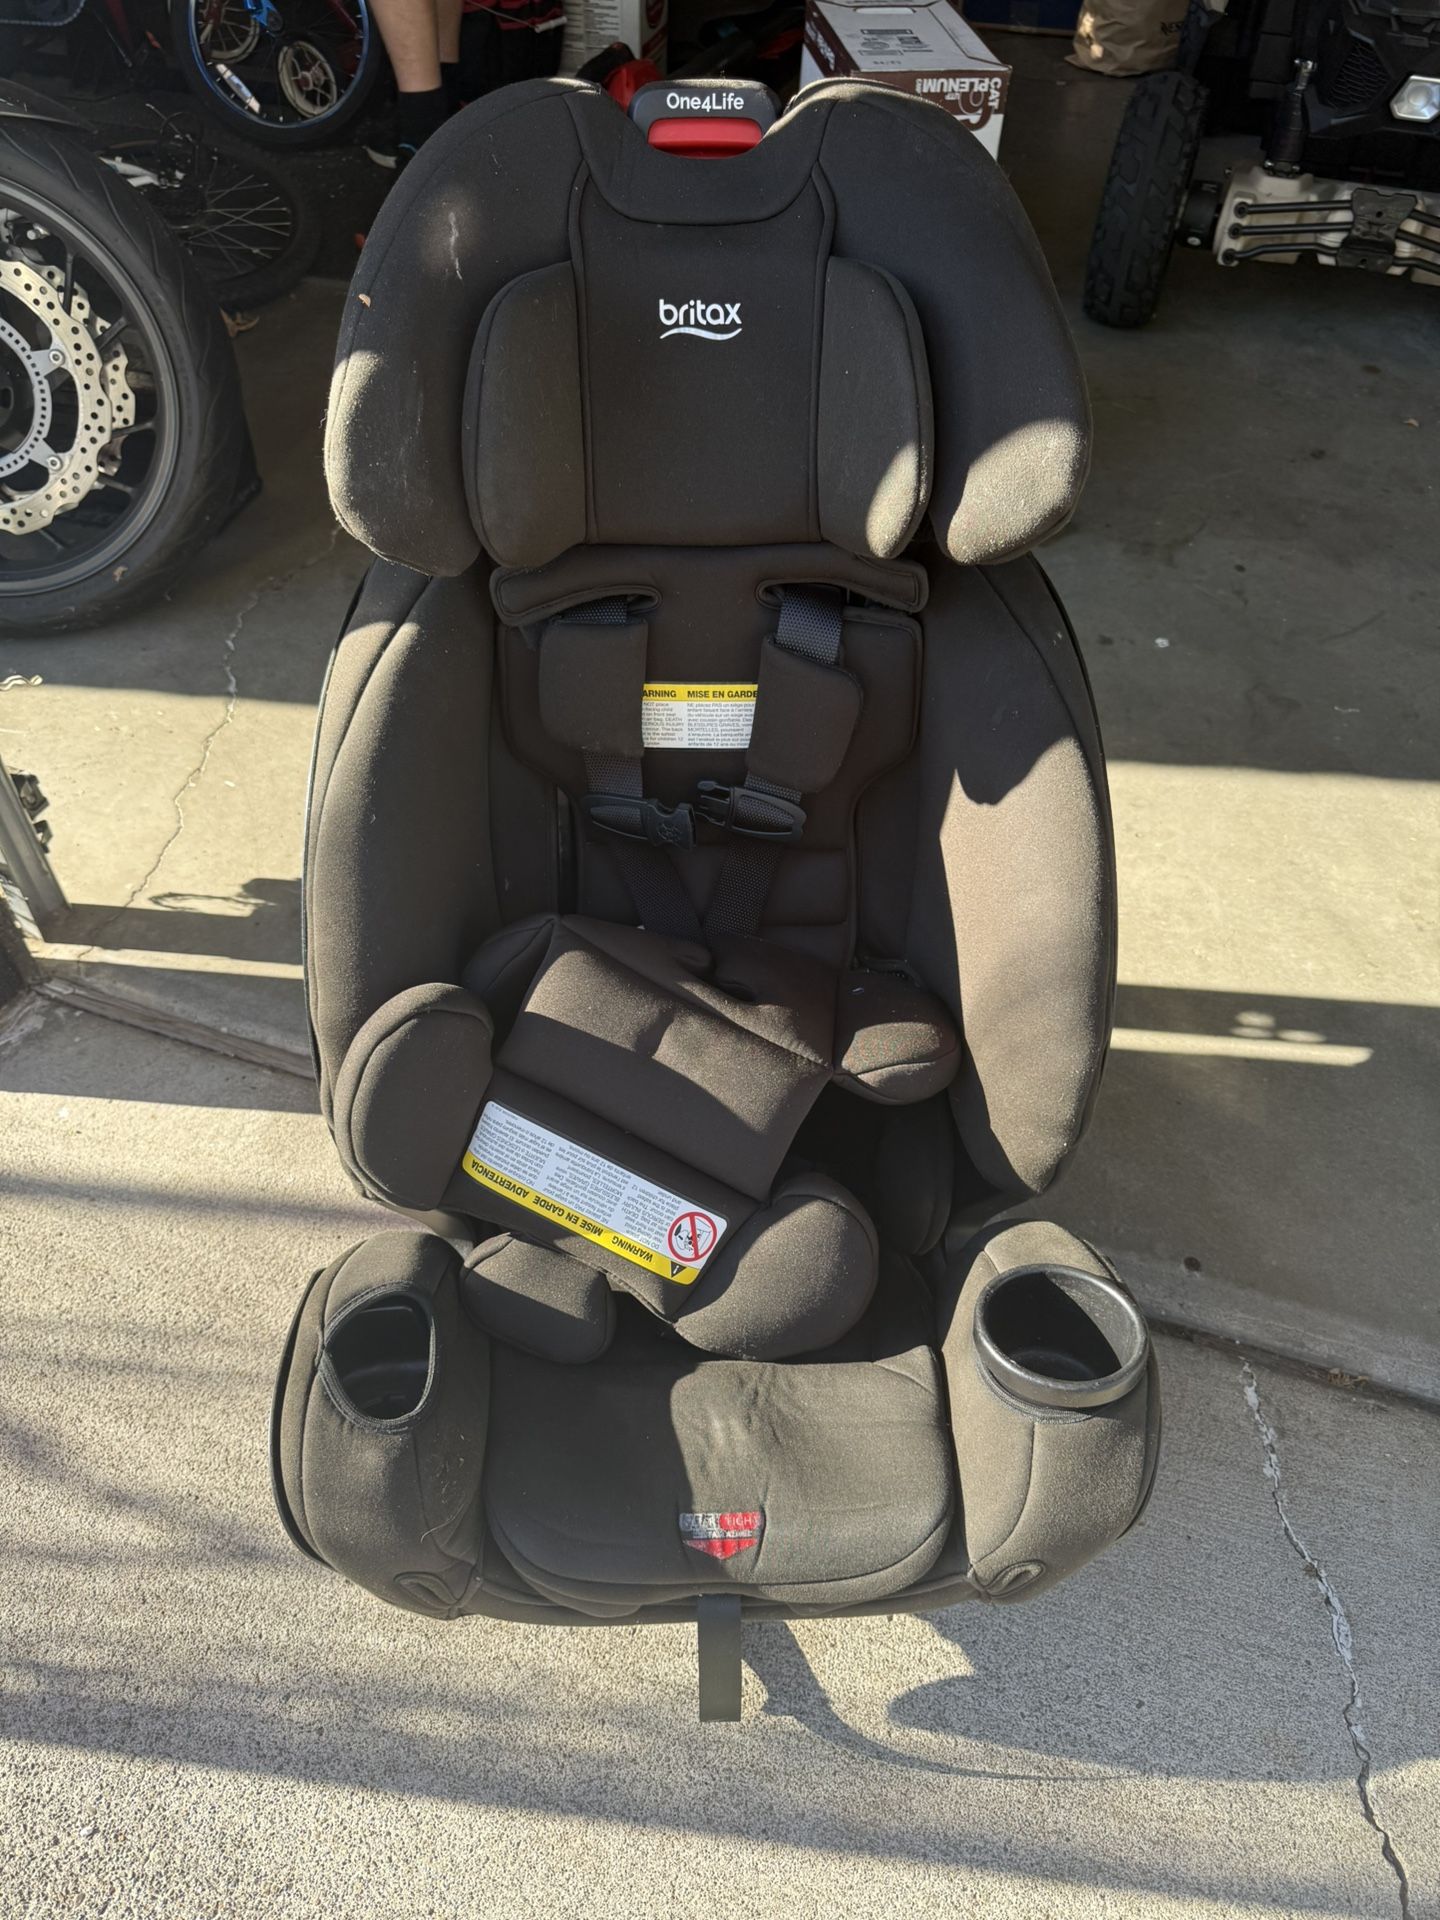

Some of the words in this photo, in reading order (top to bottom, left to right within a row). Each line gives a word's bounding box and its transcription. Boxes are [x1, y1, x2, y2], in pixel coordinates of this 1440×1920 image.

[922, 77, 990, 93] PLENUM
[988, 77, 1002, 109] CAT
[666, 92, 745, 113] One4Life
[659, 299, 742, 326] britax
[643, 690, 676, 698] ARNING
[687, 690, 710, 698] MISE
[712, 690, 725, 698] EN
[727, 690, 758, 699] GARDE
[470, 1159, 529, 1198] ADVERTENCIA
[532, 1195, 565, 1217] GARDE
[564, 1211, 579, 1224] EN
[579, 1218, 603, 1236] MISE
[610, 1235, 653, 1262] WARNING
